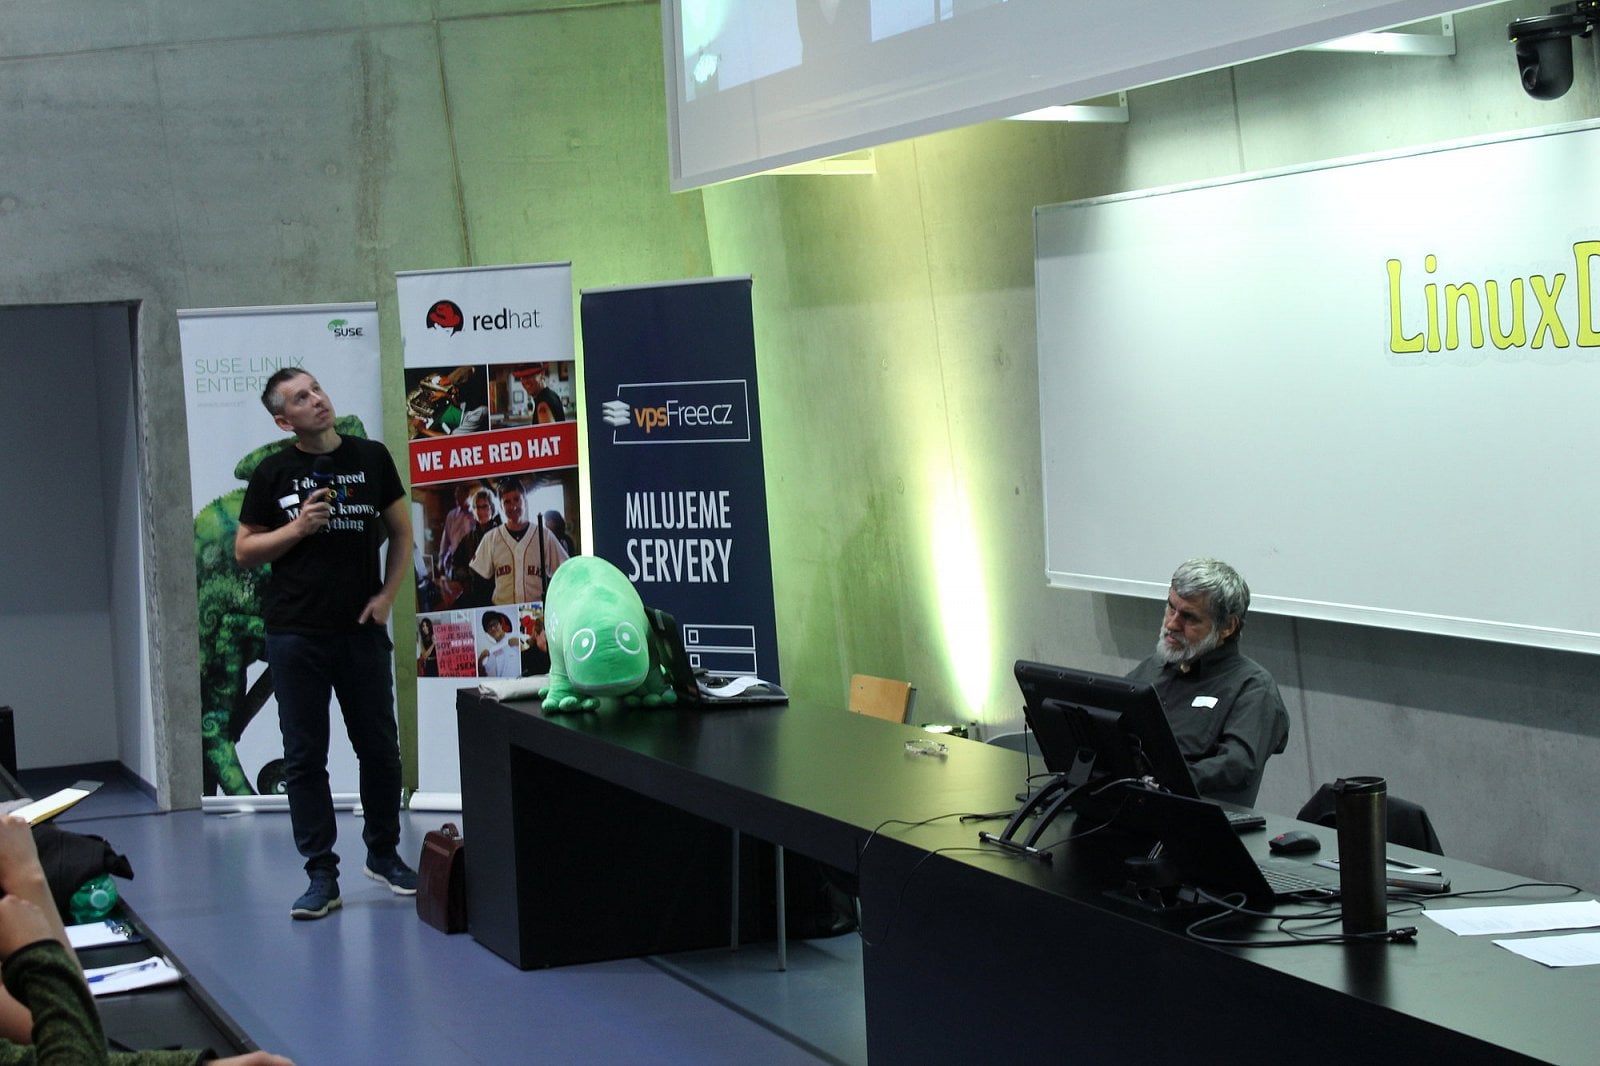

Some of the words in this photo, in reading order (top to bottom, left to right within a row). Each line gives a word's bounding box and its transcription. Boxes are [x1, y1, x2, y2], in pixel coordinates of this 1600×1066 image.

[334, 327, 363, 337] SUSE
[195, 358, 243, 375] SUSE
[634, 400, 733, 433] vpsFree.cz
[417, 451, 443, 472] WE
[449, 446, 484, 468] ARE
[488, 441, 522, 464] RED
[527, 436, 561, 459] HAT
[292, 479, 300, 491] I
[335, 471, 366, 485] need
[626, 491, 732, 529] MILUJEME
[626, 538, 733, 583] SERVERY
